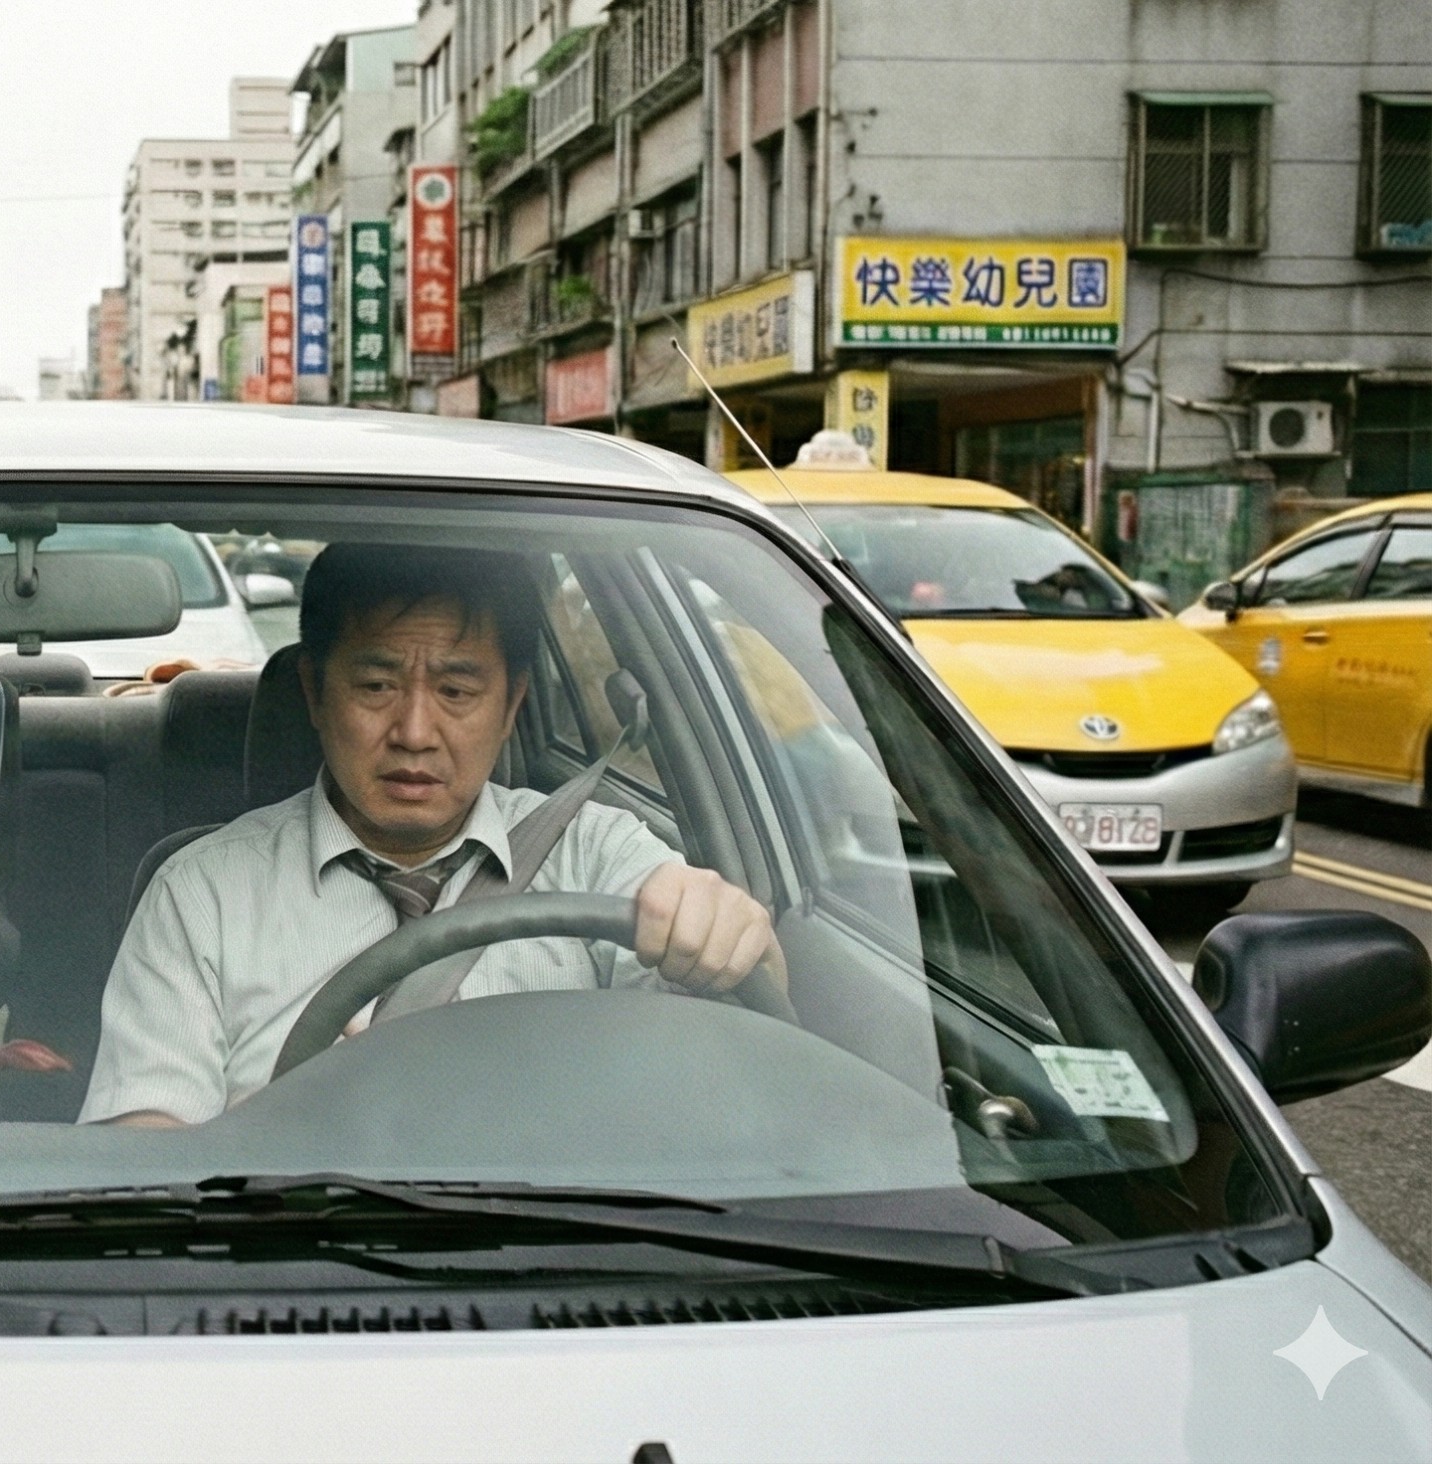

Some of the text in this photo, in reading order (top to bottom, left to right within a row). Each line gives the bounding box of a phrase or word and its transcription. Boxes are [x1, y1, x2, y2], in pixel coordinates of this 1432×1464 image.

[855, 255, 1109, 308] 快樂幼兒園
